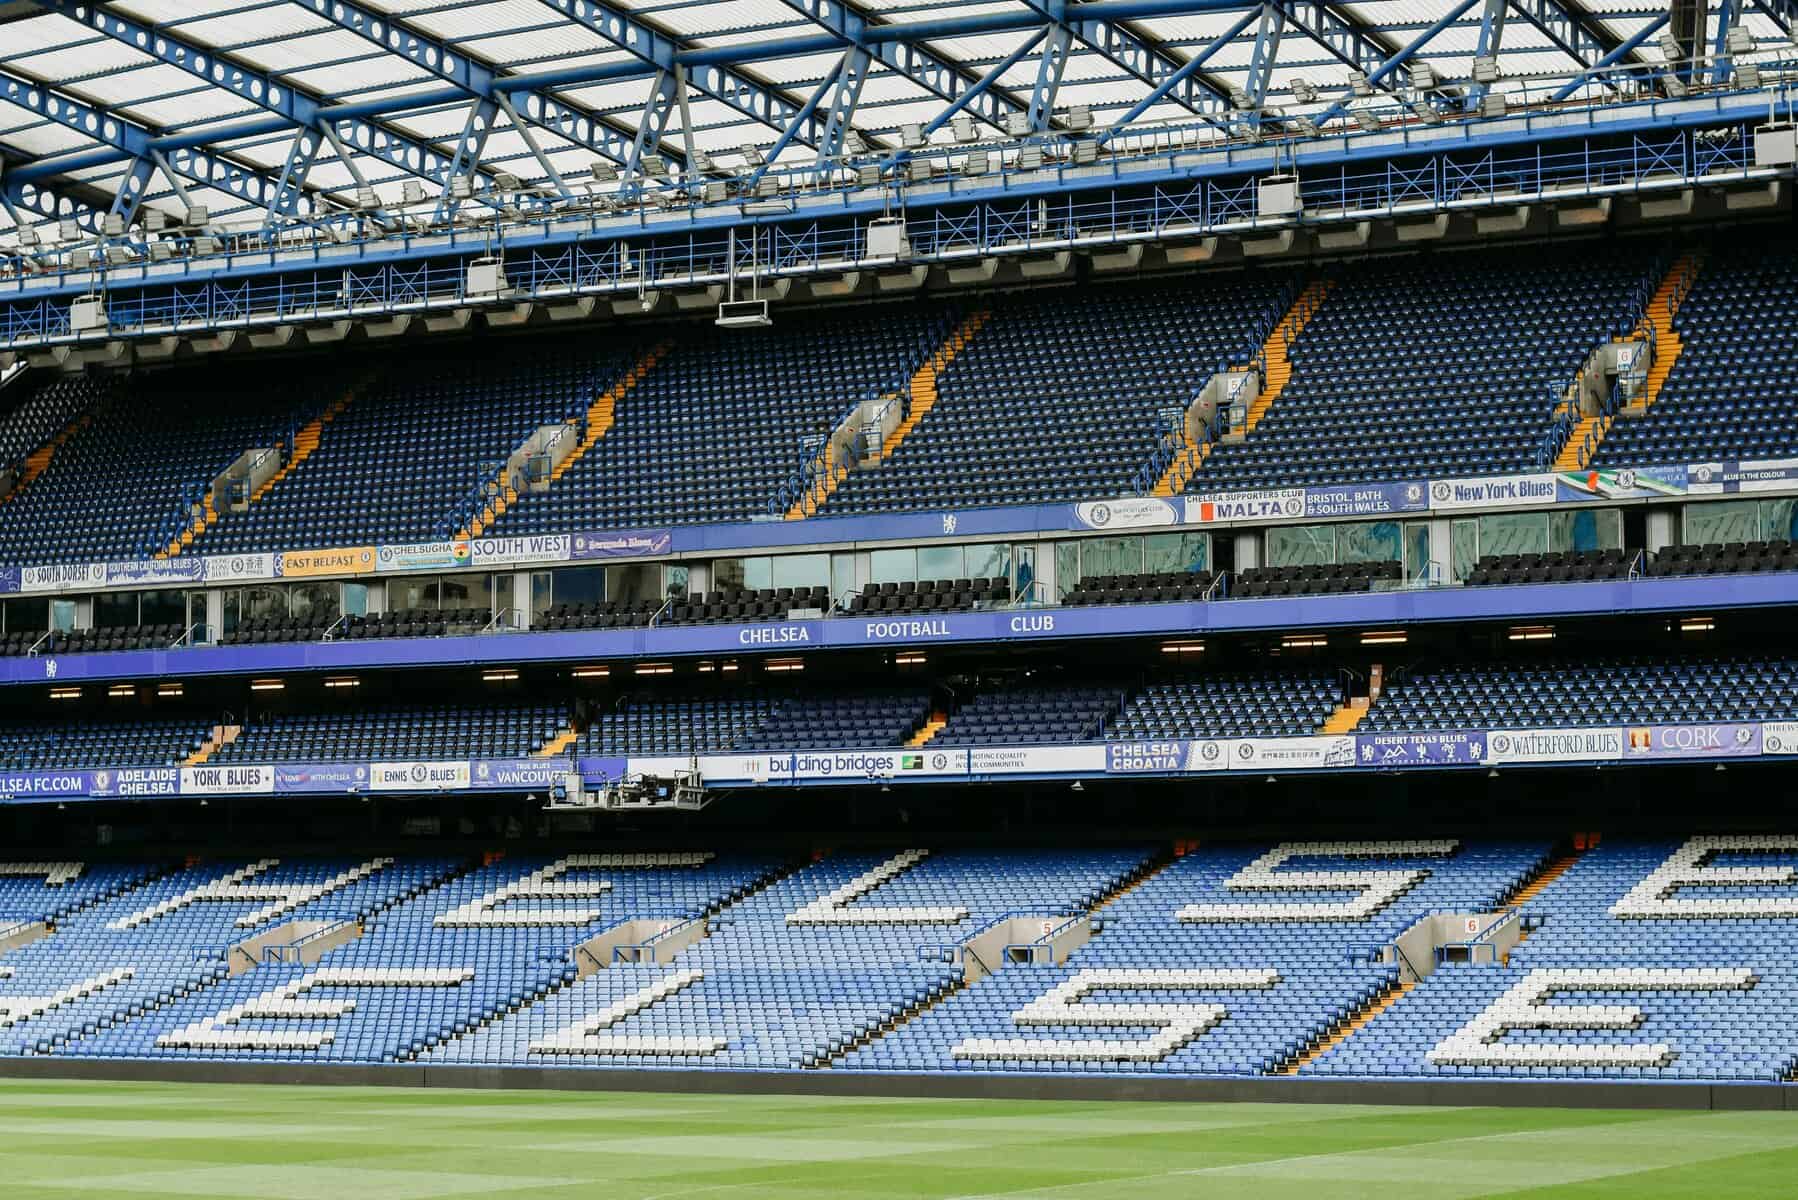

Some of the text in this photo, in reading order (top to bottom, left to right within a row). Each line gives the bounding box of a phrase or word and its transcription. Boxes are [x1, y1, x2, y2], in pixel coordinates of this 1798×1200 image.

[1760, 471, 1786, 479] COLOUR
[1187, 489, 1304, 503] CHELSEA SUPPORTERS CLUB
[1355, 490, 1382, 501] BATH
[1455, 480, 1553, 501] New York Blues
[1217, 502, 1282, 518] MALTA
[1307, 501, 1390, 514] & SOUTH WALES
[393, 544, 452, 555] CHELSUGHA
[474, 535, 569, 556] SOUTH WEST
[171, 558, 192, 569] BLUES
[286, 554, 354, 569] EAST BELFAST
[37, 566, 61, 583] SOUTH
[61, 564, 90, 582] DORSET
[739, 615, 1054, 644] CHELSEA FOOTBALL CLUB
[1375, 734, 1467, 745] DESERT TEXAS BLUES
[1512, 733, 1619, 755] WATERFORD BLUES
[1661, 727, 1721, 747] CORK
[1112, 742, 1181, 757] CHELSEA
[769, 754, 894, 775] buding bridges
[1112, 757, 1179, 770] CROATIA
[117, 768, 177, 782] ADELAIDE
[193, 770, 221, 787] YORK
[227, 769, 261, 786] BLUES
[384, 768, 456, 783] ENNIS BLUES
[118, 782, 175, 796] CHELSEA
[1043, 922, 1051, 934] 5
[1468, 920, 1476, 932] 6
